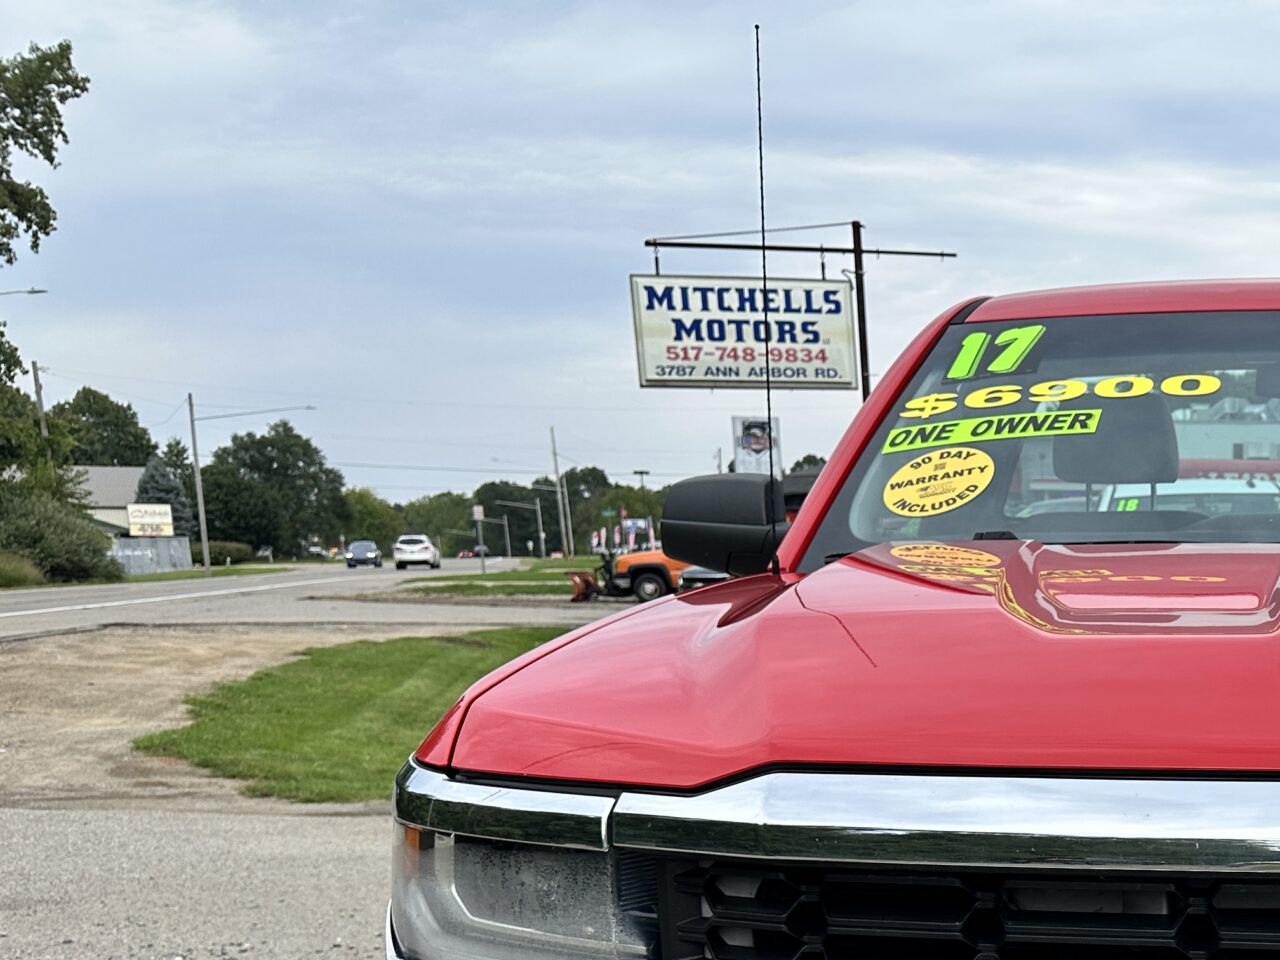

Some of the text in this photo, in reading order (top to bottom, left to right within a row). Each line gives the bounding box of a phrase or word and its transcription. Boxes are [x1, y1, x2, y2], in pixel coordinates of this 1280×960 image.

[643, 286, 842, 314] MITCHELLS
[671, 318, 821, 344] MOTORS
[666, 346, 828, 363] 517-748-9834
[946, 324, 1046, 379] 17
[655, 365, 843, 379] 3787 ANN ARBOR RD.
[900, 374, 1222, 418] $6900
[889, 412, 1094, 448] ONE OWNER
[910, 456, 932, 469] 90
[939, 451, 977, 460] DAY
[890, 465, 989, 491] WARRANTY
[892, 484, 979, 512] INCLUDED
